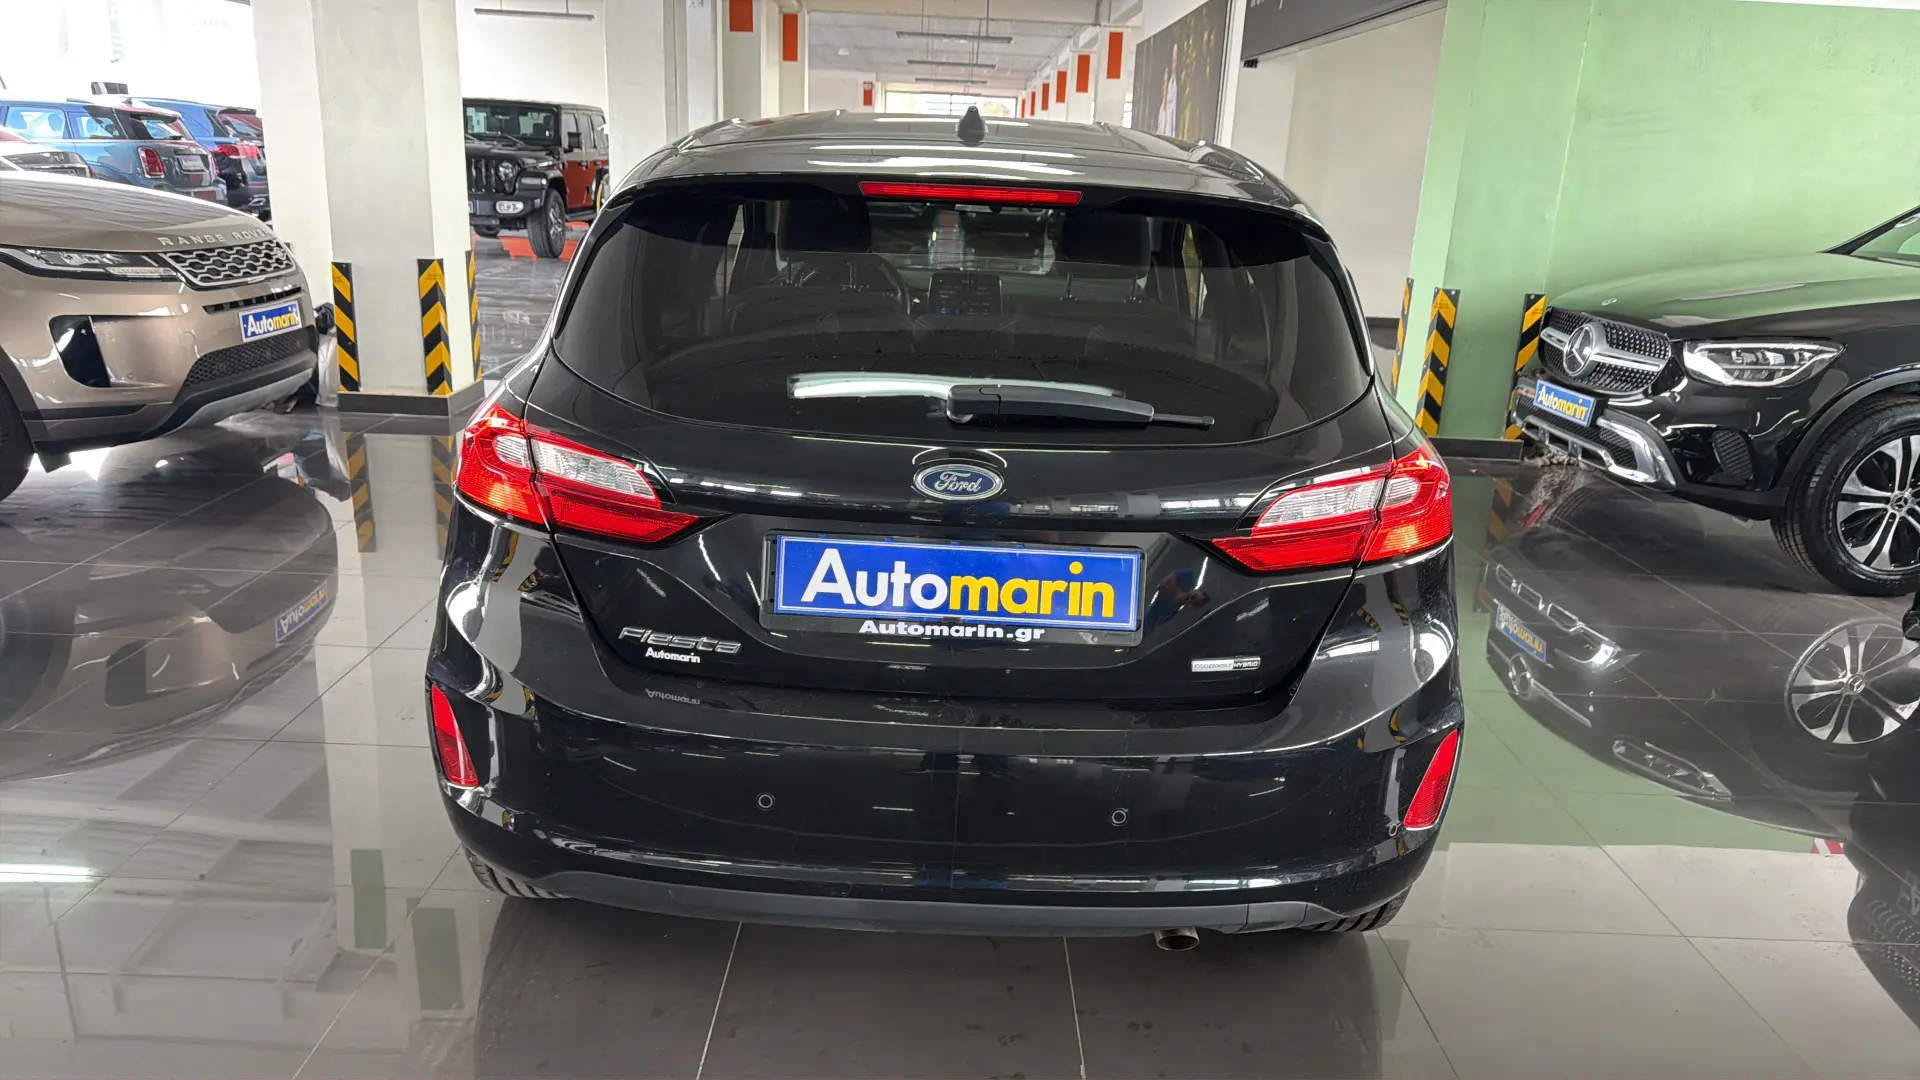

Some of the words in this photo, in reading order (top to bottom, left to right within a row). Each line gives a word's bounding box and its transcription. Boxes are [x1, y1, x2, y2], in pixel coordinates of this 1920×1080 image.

[157, 233, 227, 247] RANGE
[247, 306, 298, 337] Automarin
[1537, 384, 1589, 420] Automarin
[934, 471, 983, 492] Ford
[801, 548, 1115, 618] Automarin
[618, 627, 742, 654] Fiesta
[858, 620, 1046, 643] Automarin.gr
[644, 647, 701, 663] Automarin
